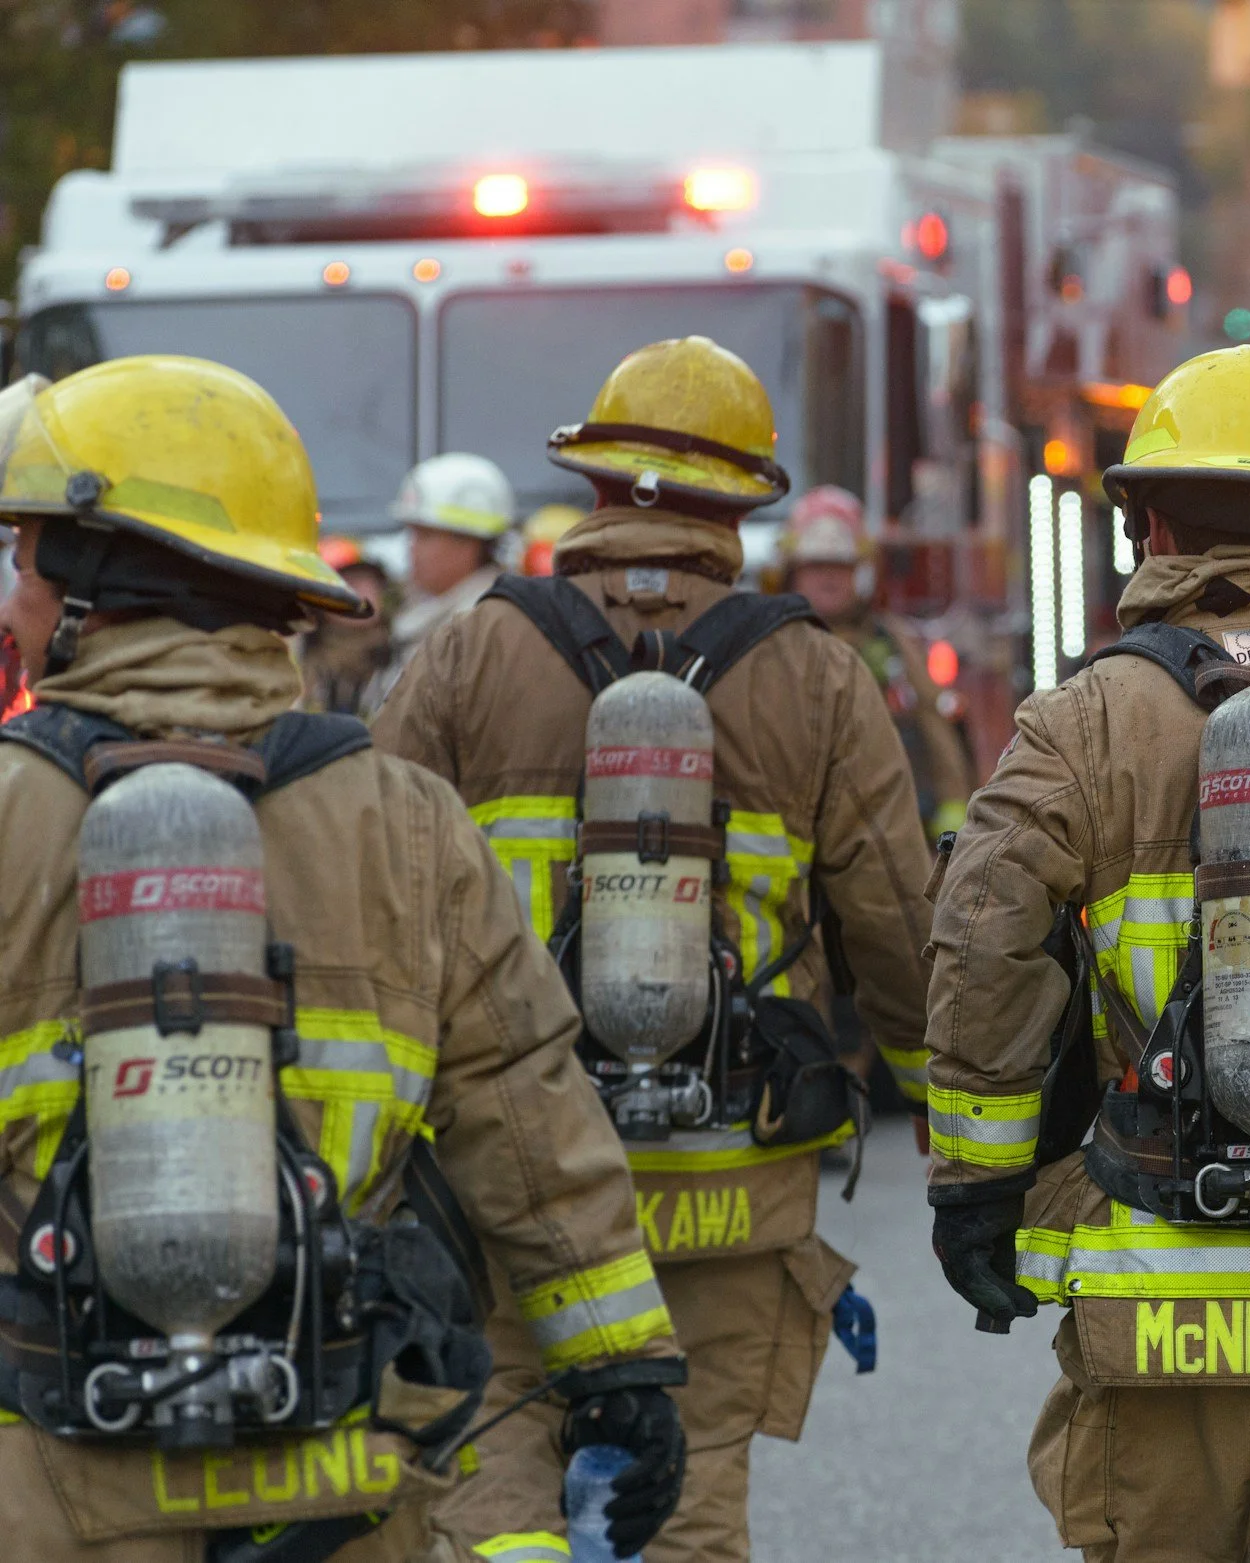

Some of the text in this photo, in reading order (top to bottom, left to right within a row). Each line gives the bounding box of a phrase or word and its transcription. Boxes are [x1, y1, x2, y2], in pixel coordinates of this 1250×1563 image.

[594, 874, 668, 893] SCOTT
[162, 1055, 263, 1081] SCOTT
[153, 1428, 401, 1514] LEONG
